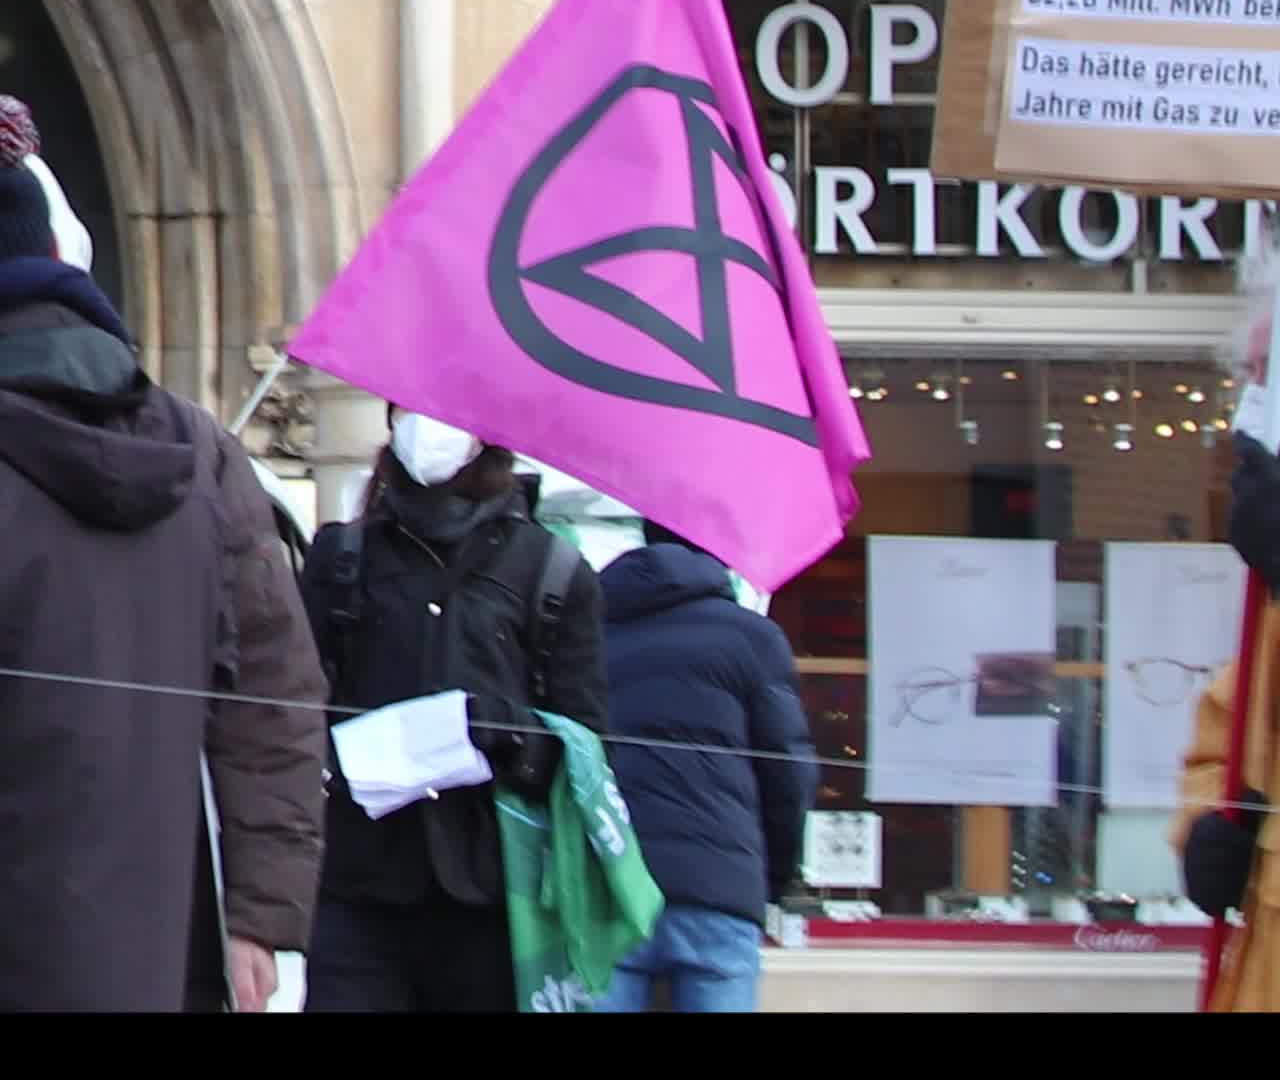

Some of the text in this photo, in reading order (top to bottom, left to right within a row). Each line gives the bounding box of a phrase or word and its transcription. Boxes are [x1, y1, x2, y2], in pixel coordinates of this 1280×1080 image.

[1021, 46, 1269, 89] Das hätte gereicht,
[1016, 88, 1092, 117] Jahre
[1101, 95, 1144, 120] mit
[1153, 96, 1200, 121] Gas
[1208, 106, 1239, 126] zu
